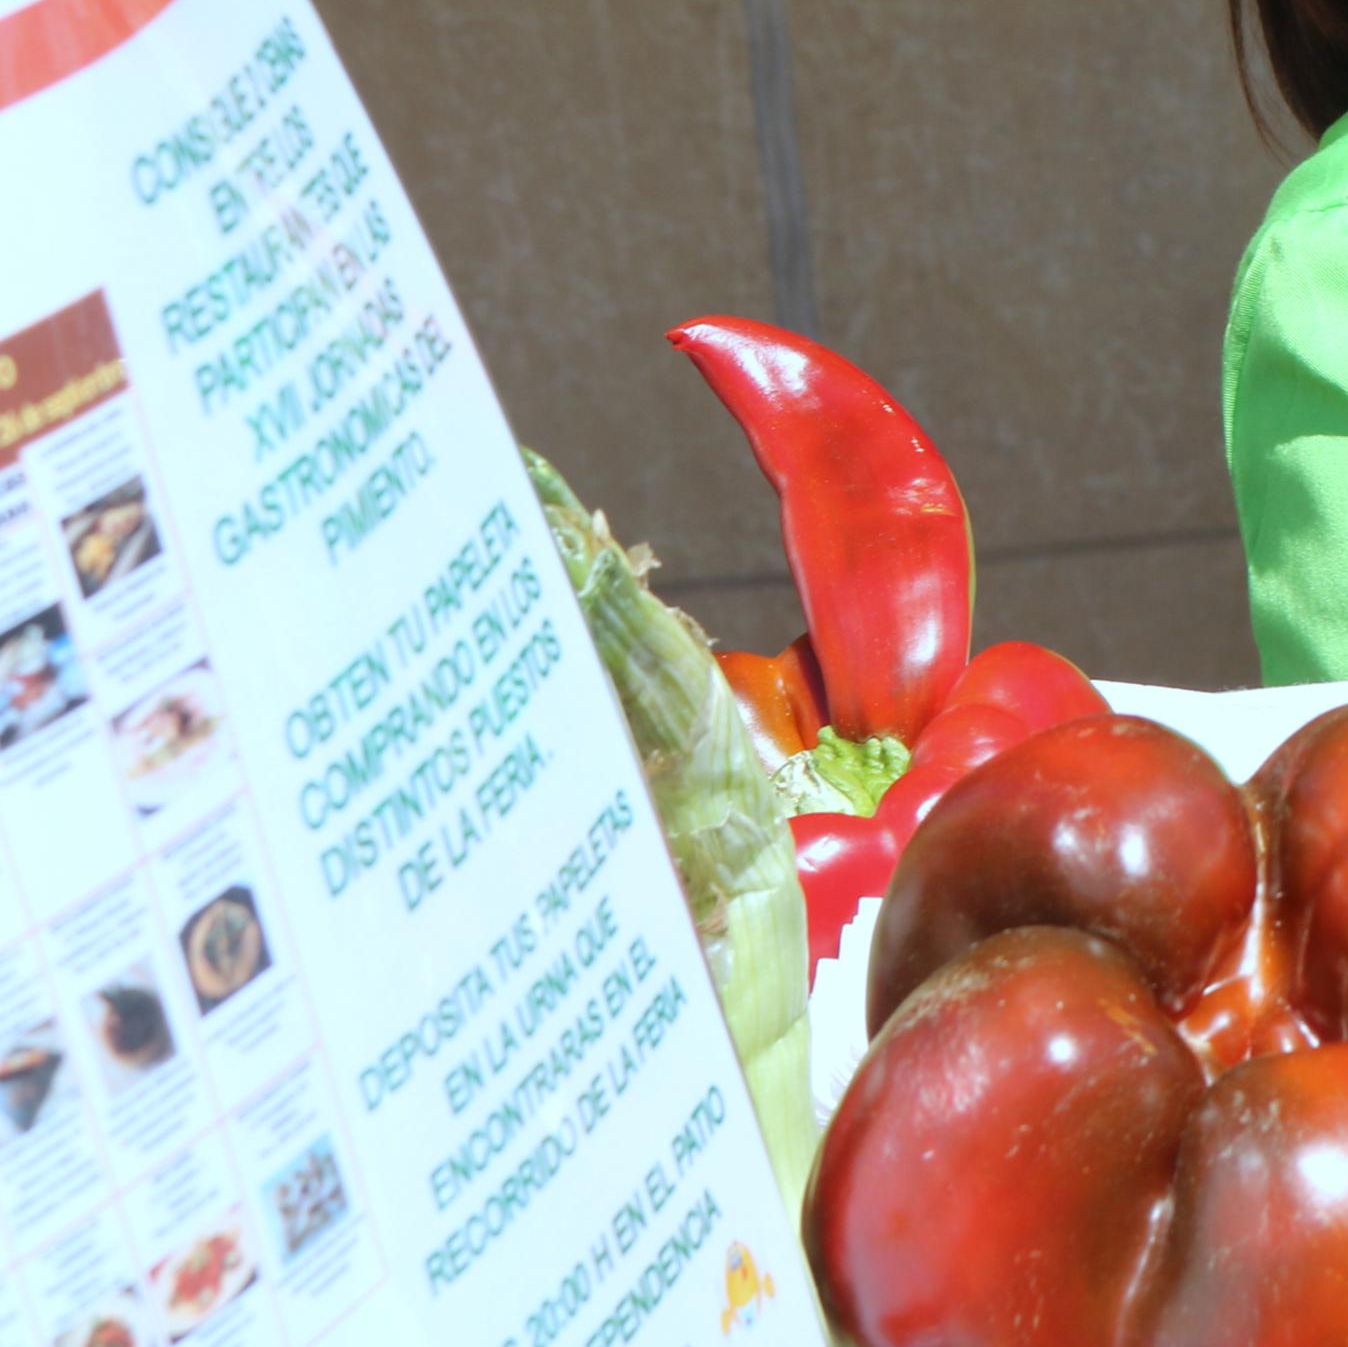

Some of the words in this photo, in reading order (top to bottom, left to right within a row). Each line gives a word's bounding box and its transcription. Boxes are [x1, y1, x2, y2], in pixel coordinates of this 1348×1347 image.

[285, 640, 391, 760] OBTEN
[386, 603, 427, 667] TU
[423, 500, 521, 626] PAPELETA
[299, 639, 476, 831] COMPRANDO
[472, 602, 509, 665] EN
[499, 555, 542, 629] LOS
[319, 728, 470, 900] DISTINTOS
[469, 618, 563, 754] PUESTOS
[358, 964, 496, 1113] DEPOSITA
[488, 911, 538, 980] TUS
[536, 788, 634, 935] PAPELETAS
[396, 840, 444, 912] DE
[441, 807, 482, 868] LA
[425, 1115, 579, 1298] RECORRIDO
[575, 1073, 611, 1135] DE
[609, 1044, 639, 1096] LA
[632, 974, 687, 1062] FERIA
[429, 998, 606, 1212] ENCONTRARAS
[602, 960, 633, 1020] EN
[629, 936, 657, 982] EL
[443, 1053, 487, 1116] EN
[485, 1021, 522, 1075] LA
[515, 951, 579, 1038] URNA
[575, 895, 618, 968] QUE
[590, 1233, 615, 1284] H
[611, 1190, 648, 1256] EN
[644, 1161, 675, 1213] EL
[670, 1084, 726, 1179] PATIO
